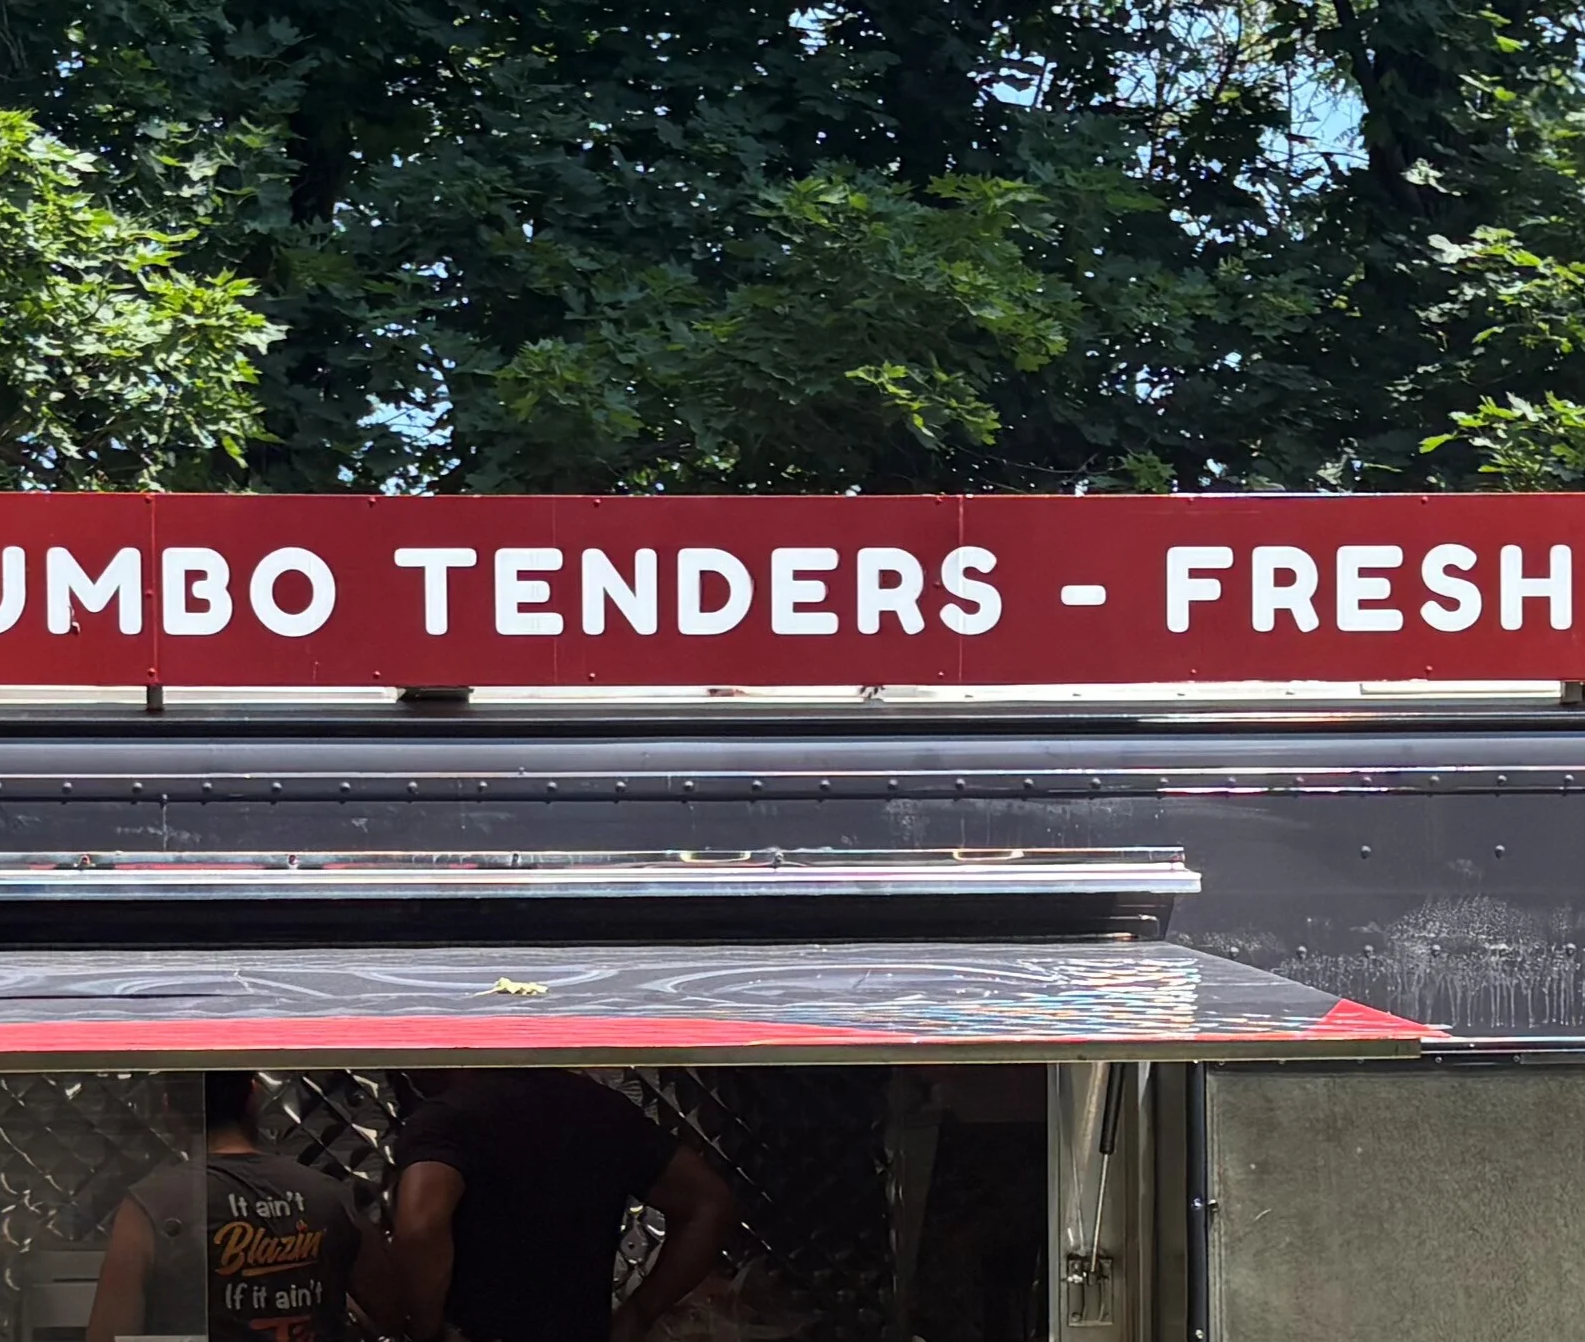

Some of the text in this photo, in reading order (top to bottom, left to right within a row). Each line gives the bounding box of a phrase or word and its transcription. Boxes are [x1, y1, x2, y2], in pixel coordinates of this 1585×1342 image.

[394, 546, 1002, 636] TENDERS
[1166, 543, 1573, 633] FRESH
[229, 1190, 306, 1218] It ain't
[225, 1279, 324, 1311] If it ain't
